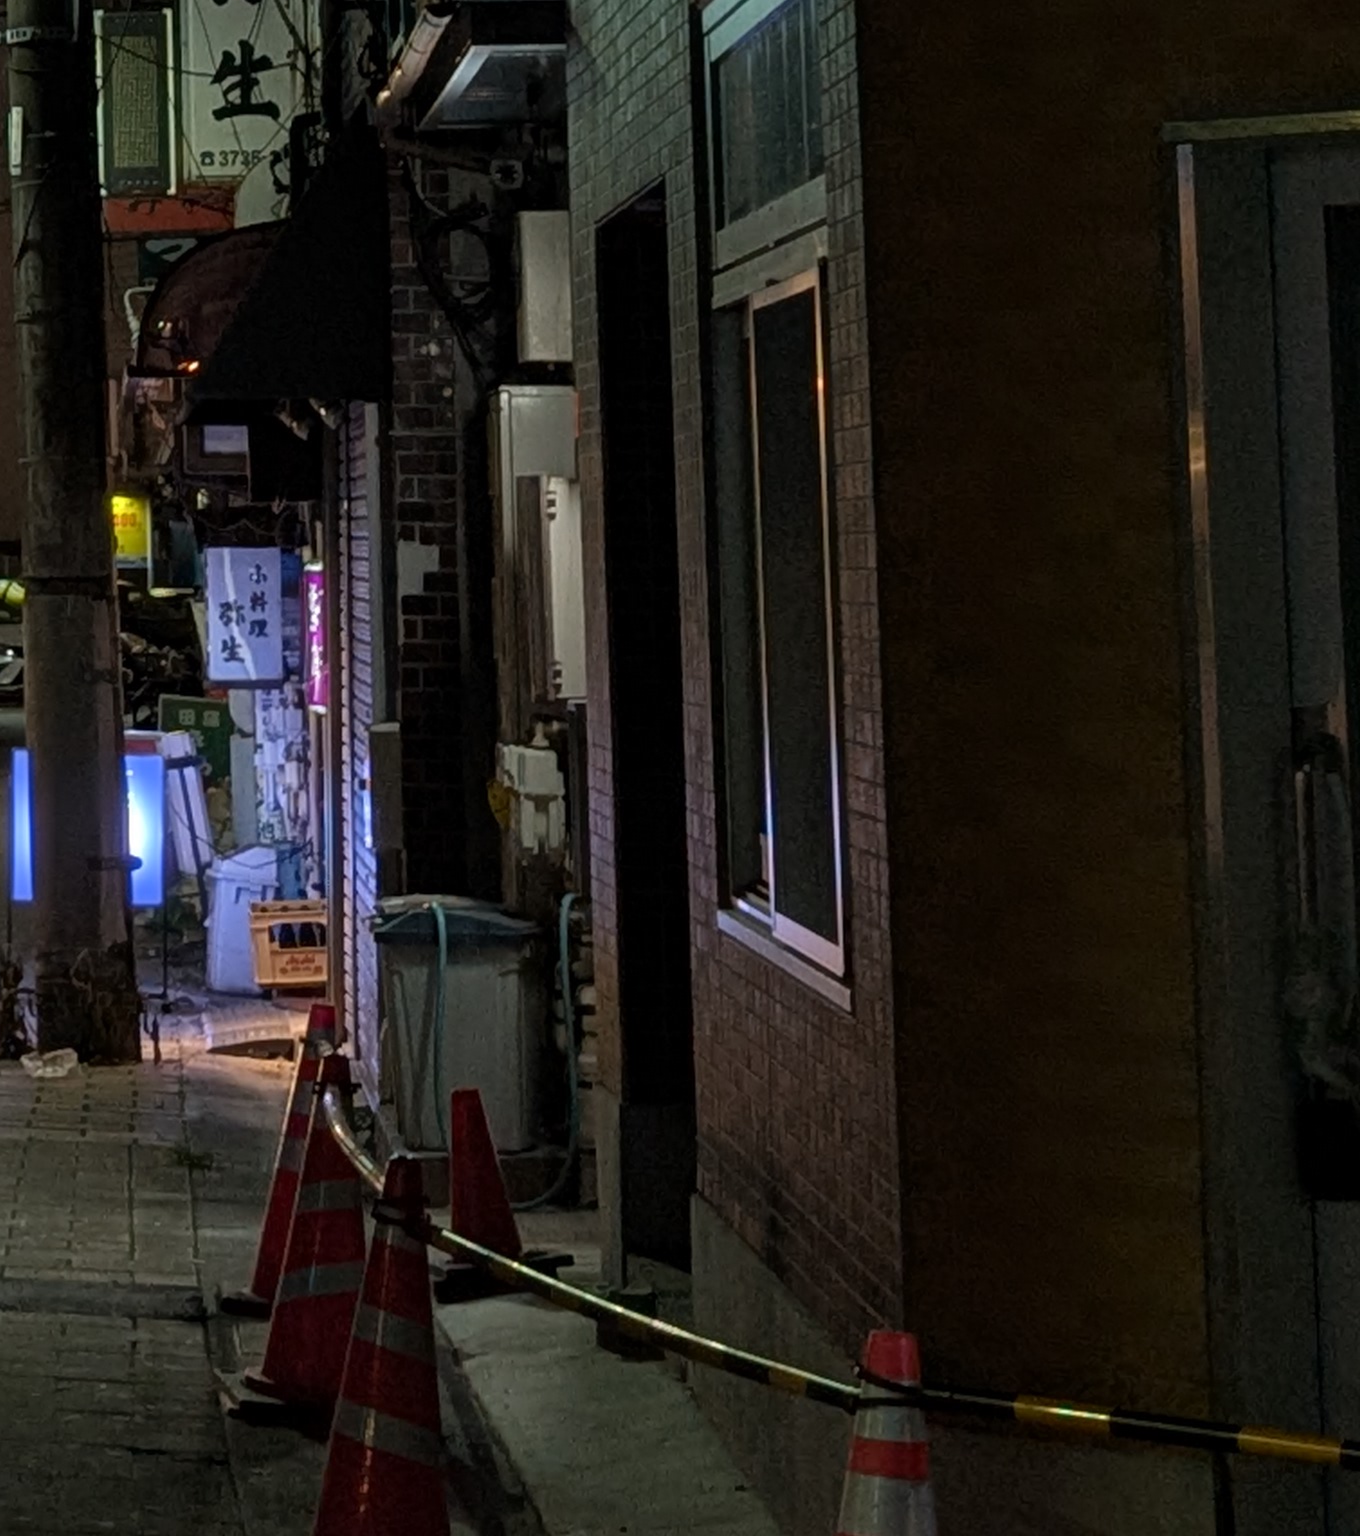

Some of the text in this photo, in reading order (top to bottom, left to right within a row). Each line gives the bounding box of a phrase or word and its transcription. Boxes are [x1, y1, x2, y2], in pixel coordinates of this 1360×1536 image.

[218, 598, 247, 664] 弥生
[248, 563, 269, 639] 小料理
